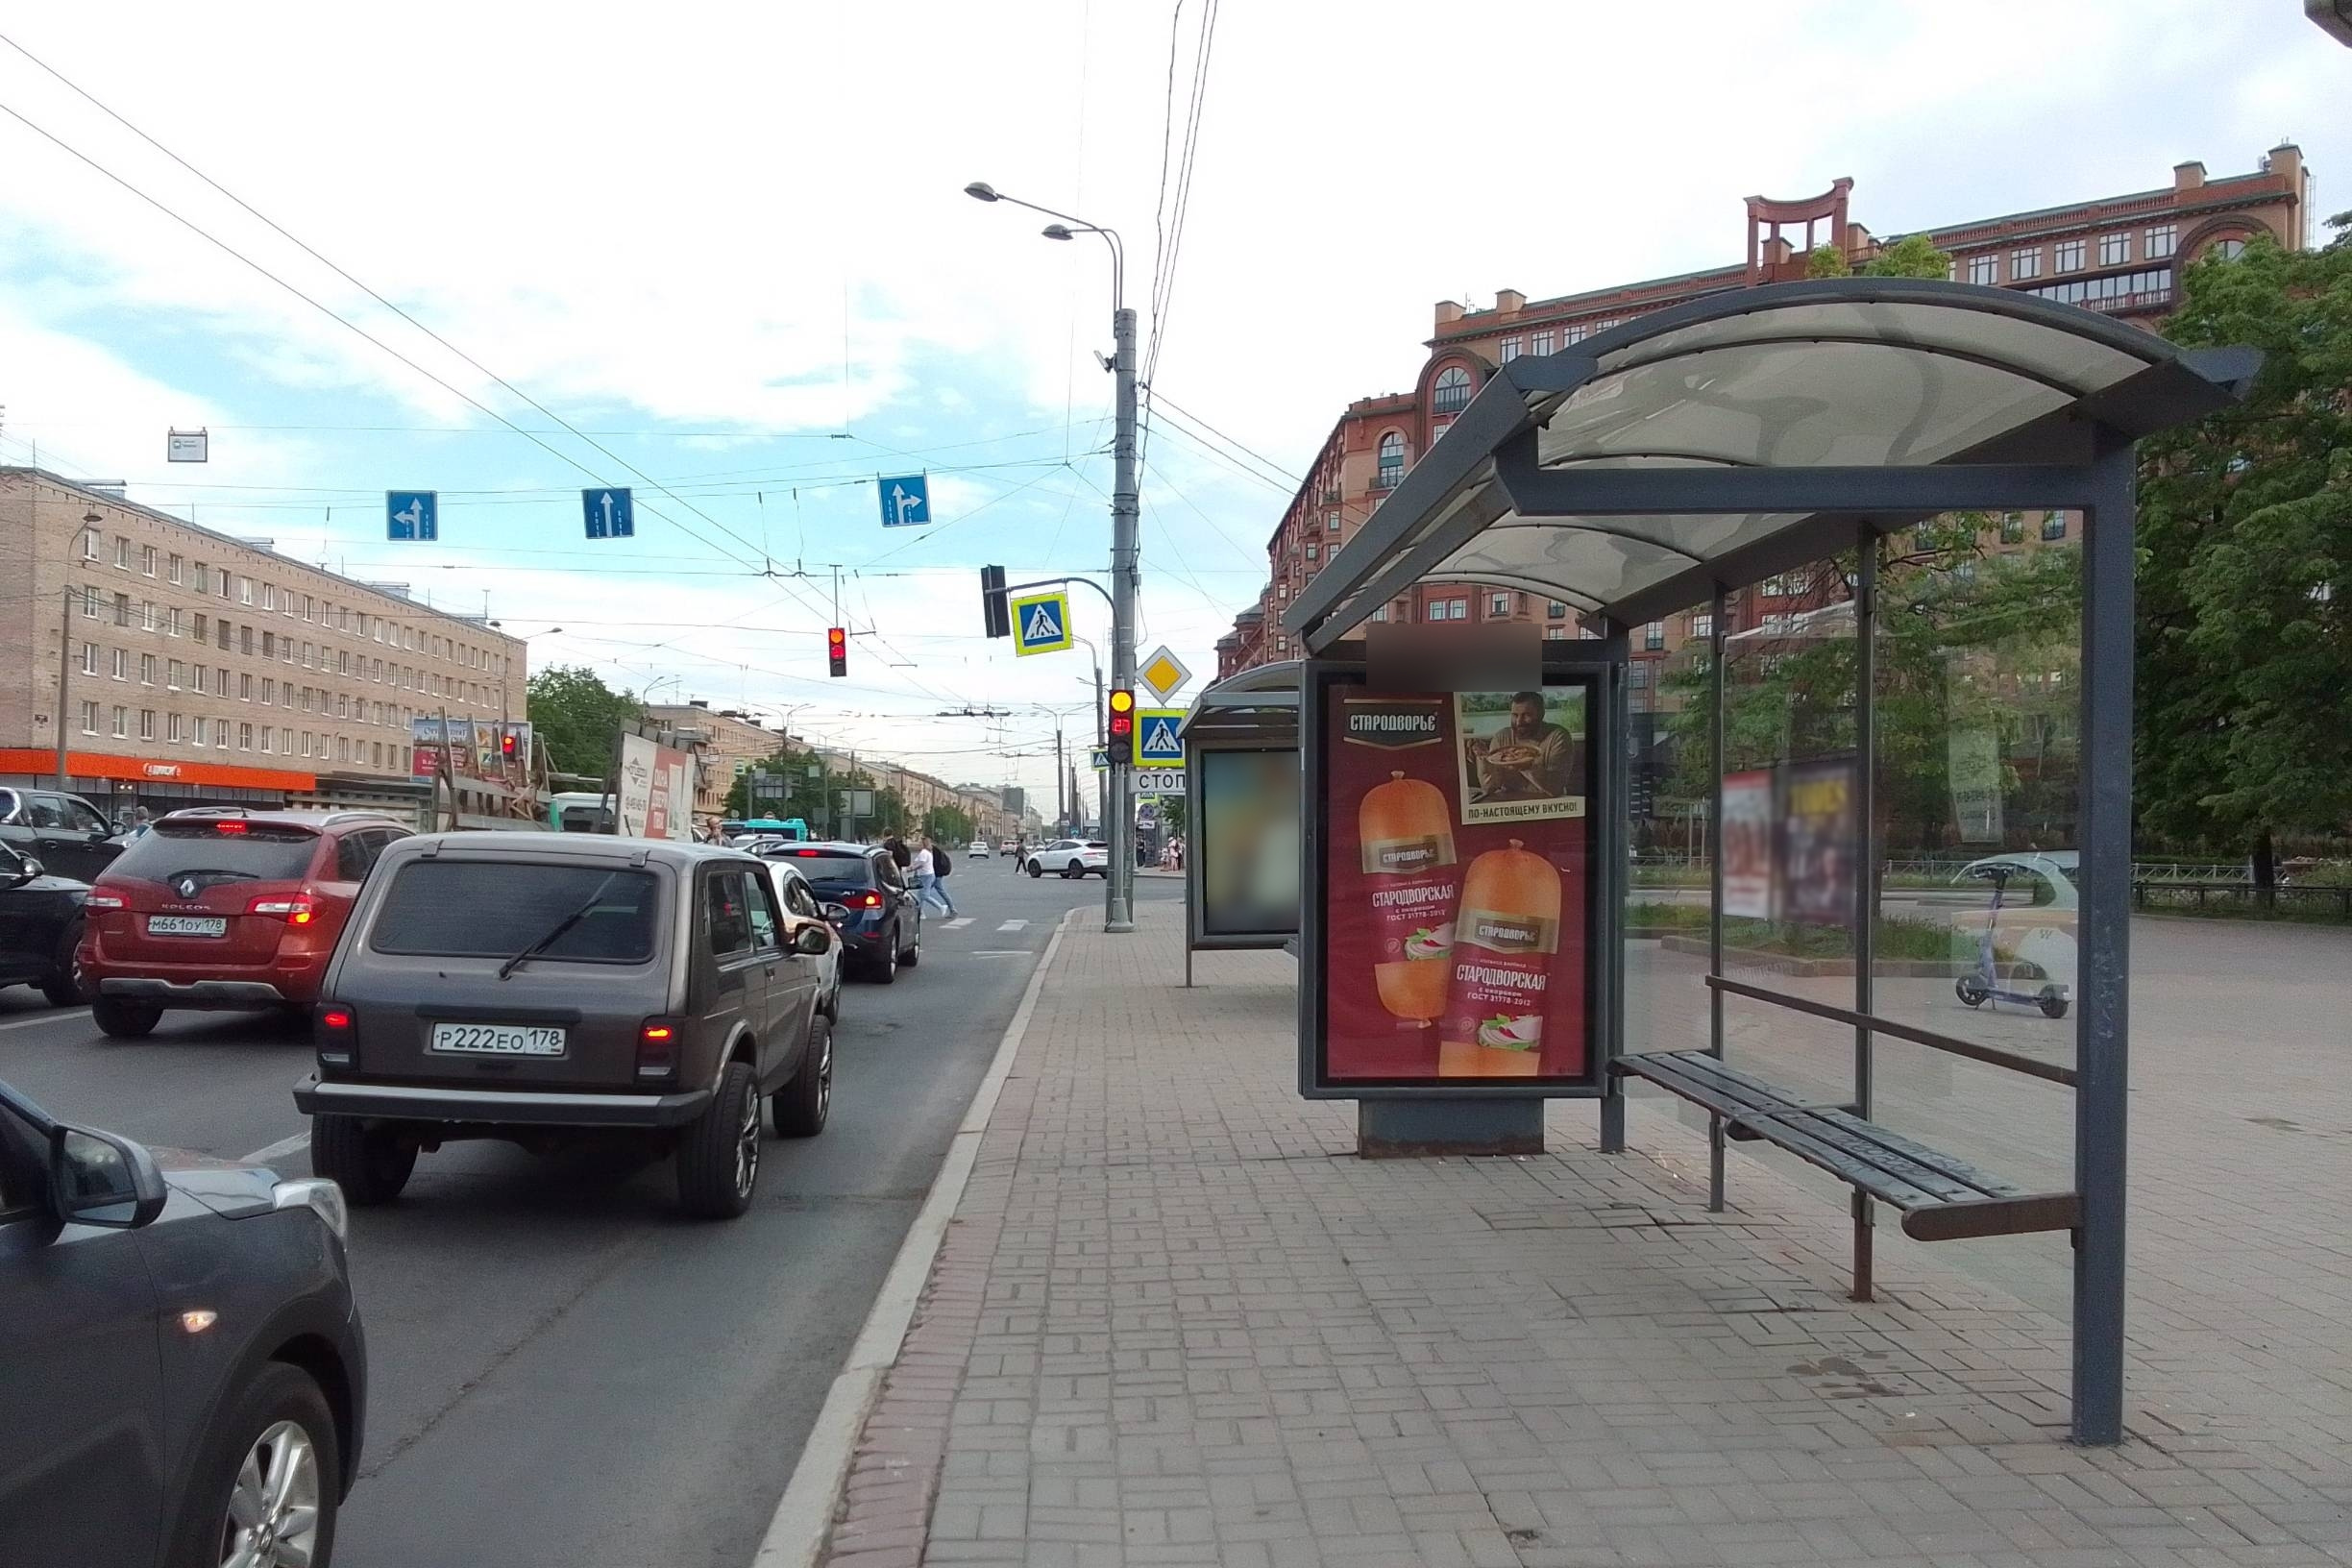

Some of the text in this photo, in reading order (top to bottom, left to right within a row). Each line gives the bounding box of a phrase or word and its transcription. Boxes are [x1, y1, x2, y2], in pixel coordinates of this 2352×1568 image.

[1350, 714, 1435, 731] СТАРОДВОРЬЕ
[1468, 801, 1578, 820] ПО-НАСТОЯЩЕМУ ВКУСНО!
[1372, 884, 1455, 908] СТАРОДВОРСКАЯ
[152, 918, 223, 931] М661ОУ 178
[1457, 964, 1547, 991] СТАРОДВОРСКАЯ
[1467, 992, 1489, 1000] ГОСТ
[440, 1027, 559, 1050] Р222ЕО 178
